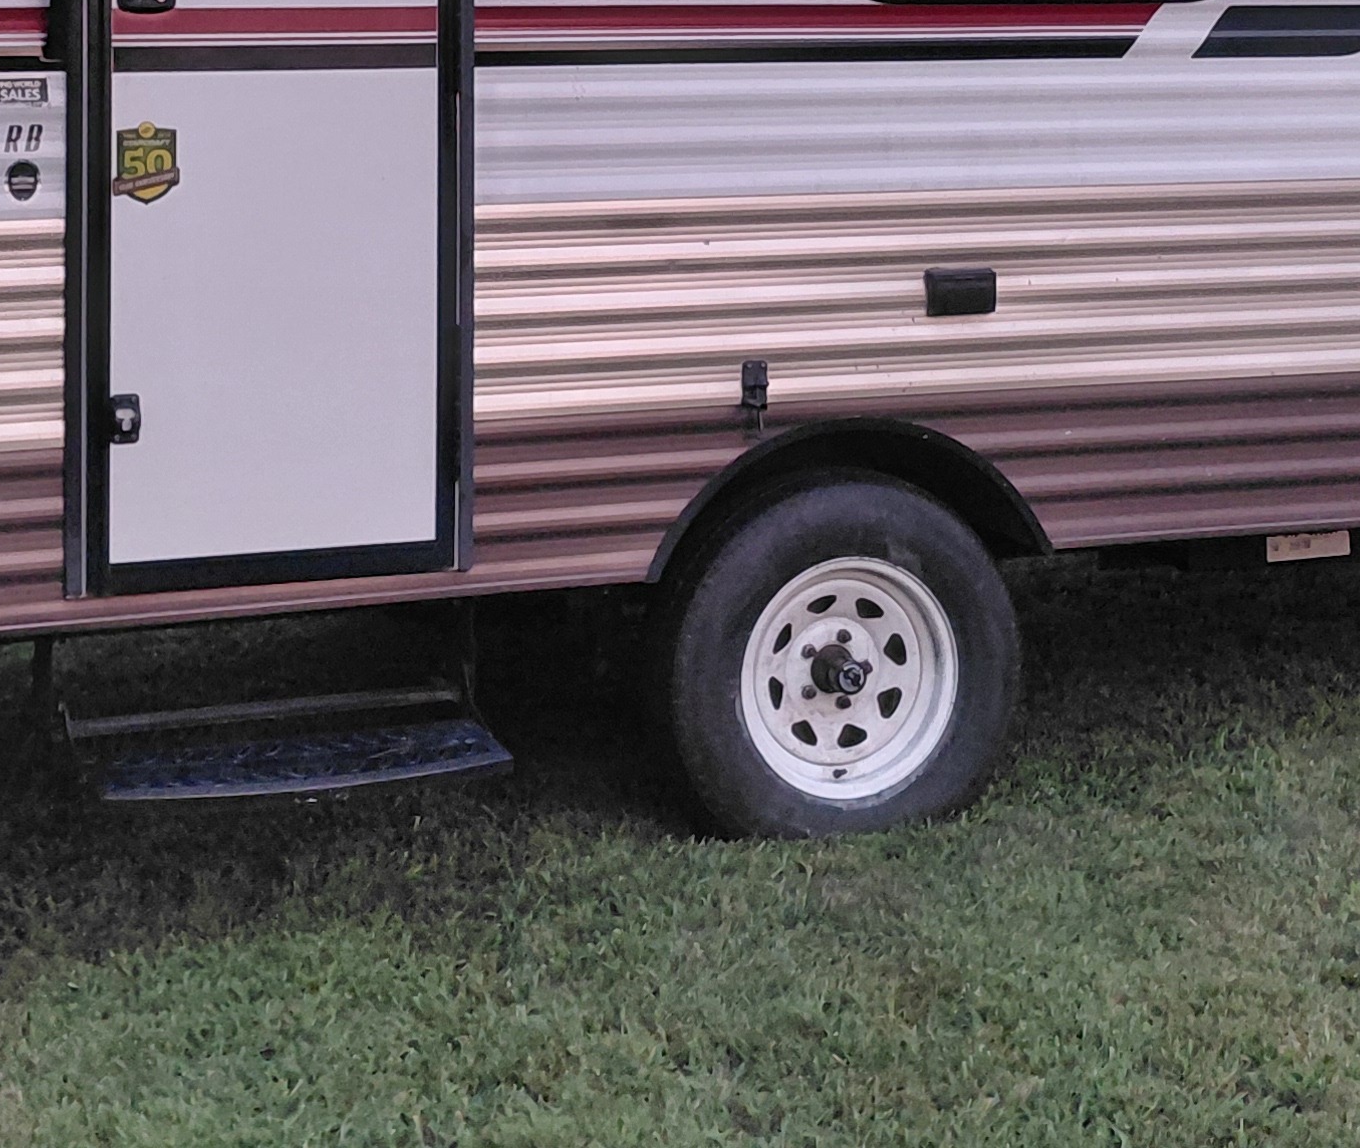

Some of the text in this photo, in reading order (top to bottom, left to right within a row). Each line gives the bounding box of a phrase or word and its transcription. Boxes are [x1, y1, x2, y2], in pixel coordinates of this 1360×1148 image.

[0, 87, 42, 101] SALES
[4, 124, 44, 152] RB
[121, 147, 173, 180] 50
